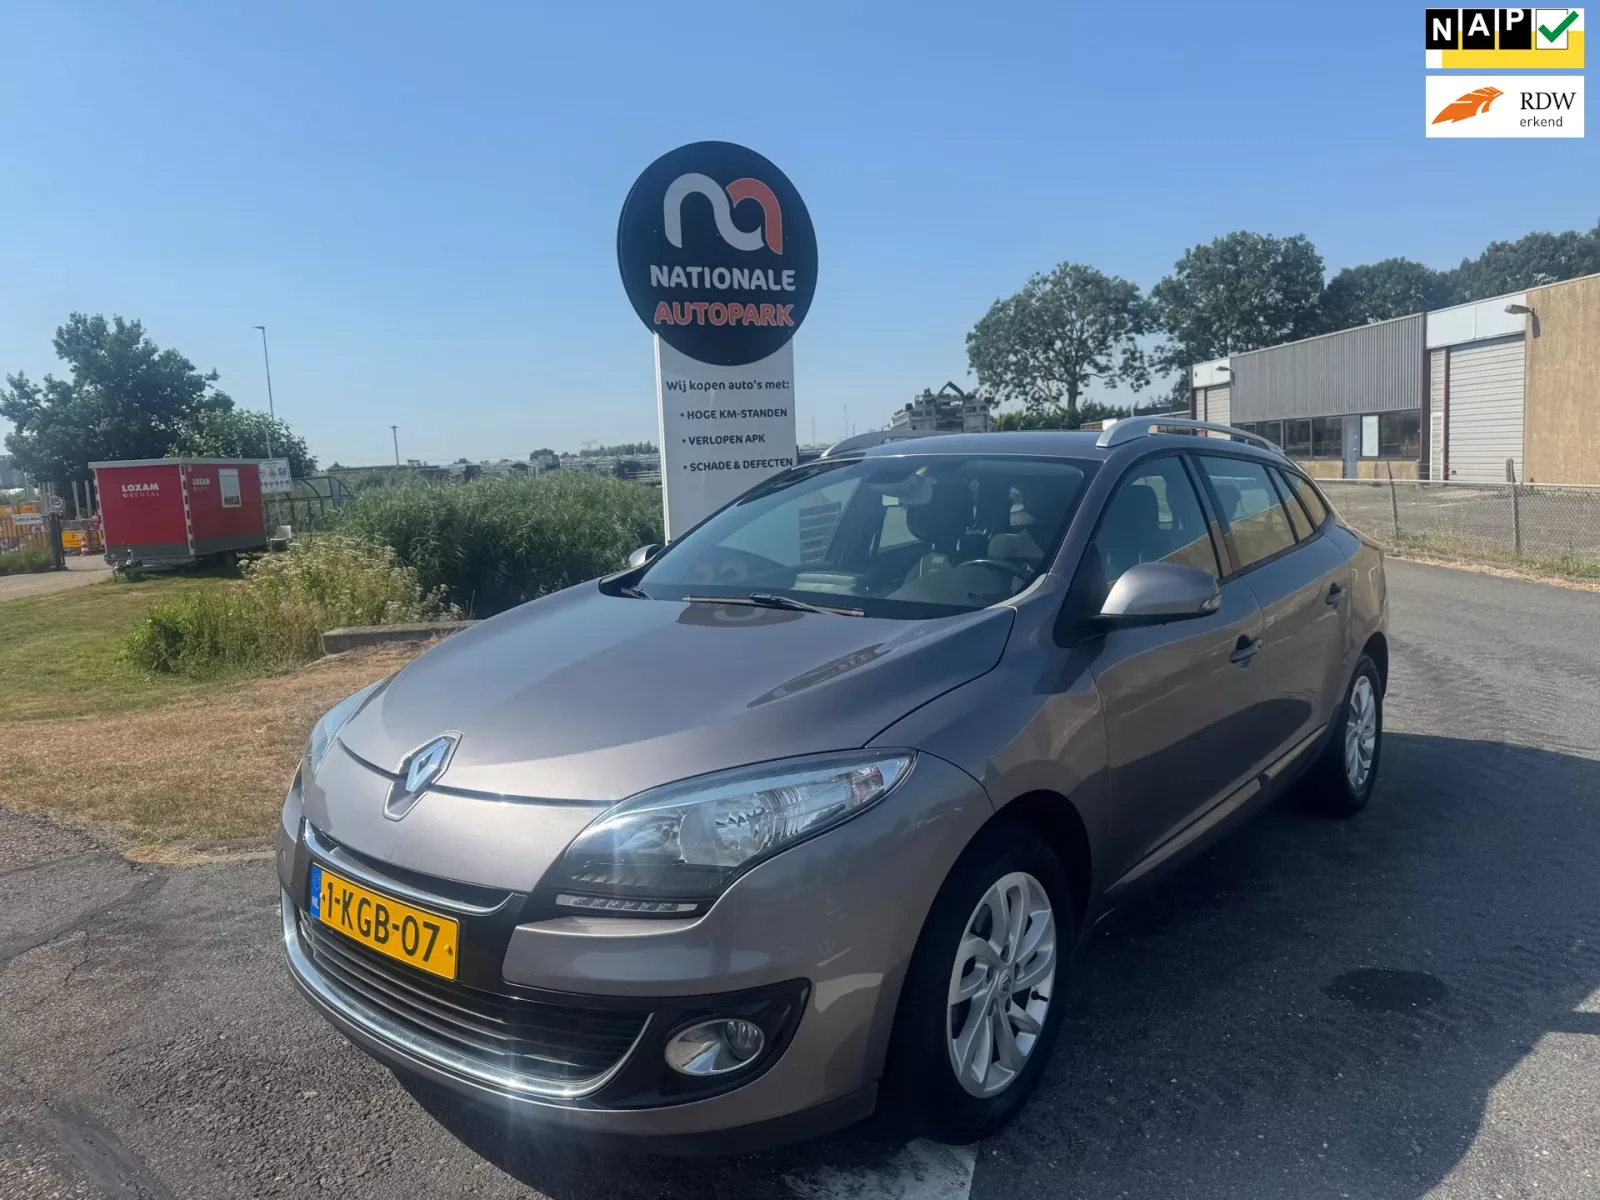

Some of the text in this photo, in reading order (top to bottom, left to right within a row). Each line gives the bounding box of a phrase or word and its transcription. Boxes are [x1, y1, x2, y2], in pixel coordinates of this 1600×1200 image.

[650, 265, 796, 291] NATIONALE
[653, 301, 795, 327] AUTOPARK
[666, 379, 790, 393] Wij kopen auto's met:
[687, 408, 788, 420] HOGE KM-STANDEN
[688, 434, 766, 446] VERLOPEN APK
[689, 458, 794, 472] SCHADE & DEFECTEN
[121, 483, 160, 493] LOXAM
[327, 881, 441, 963] 1-KGB-07
